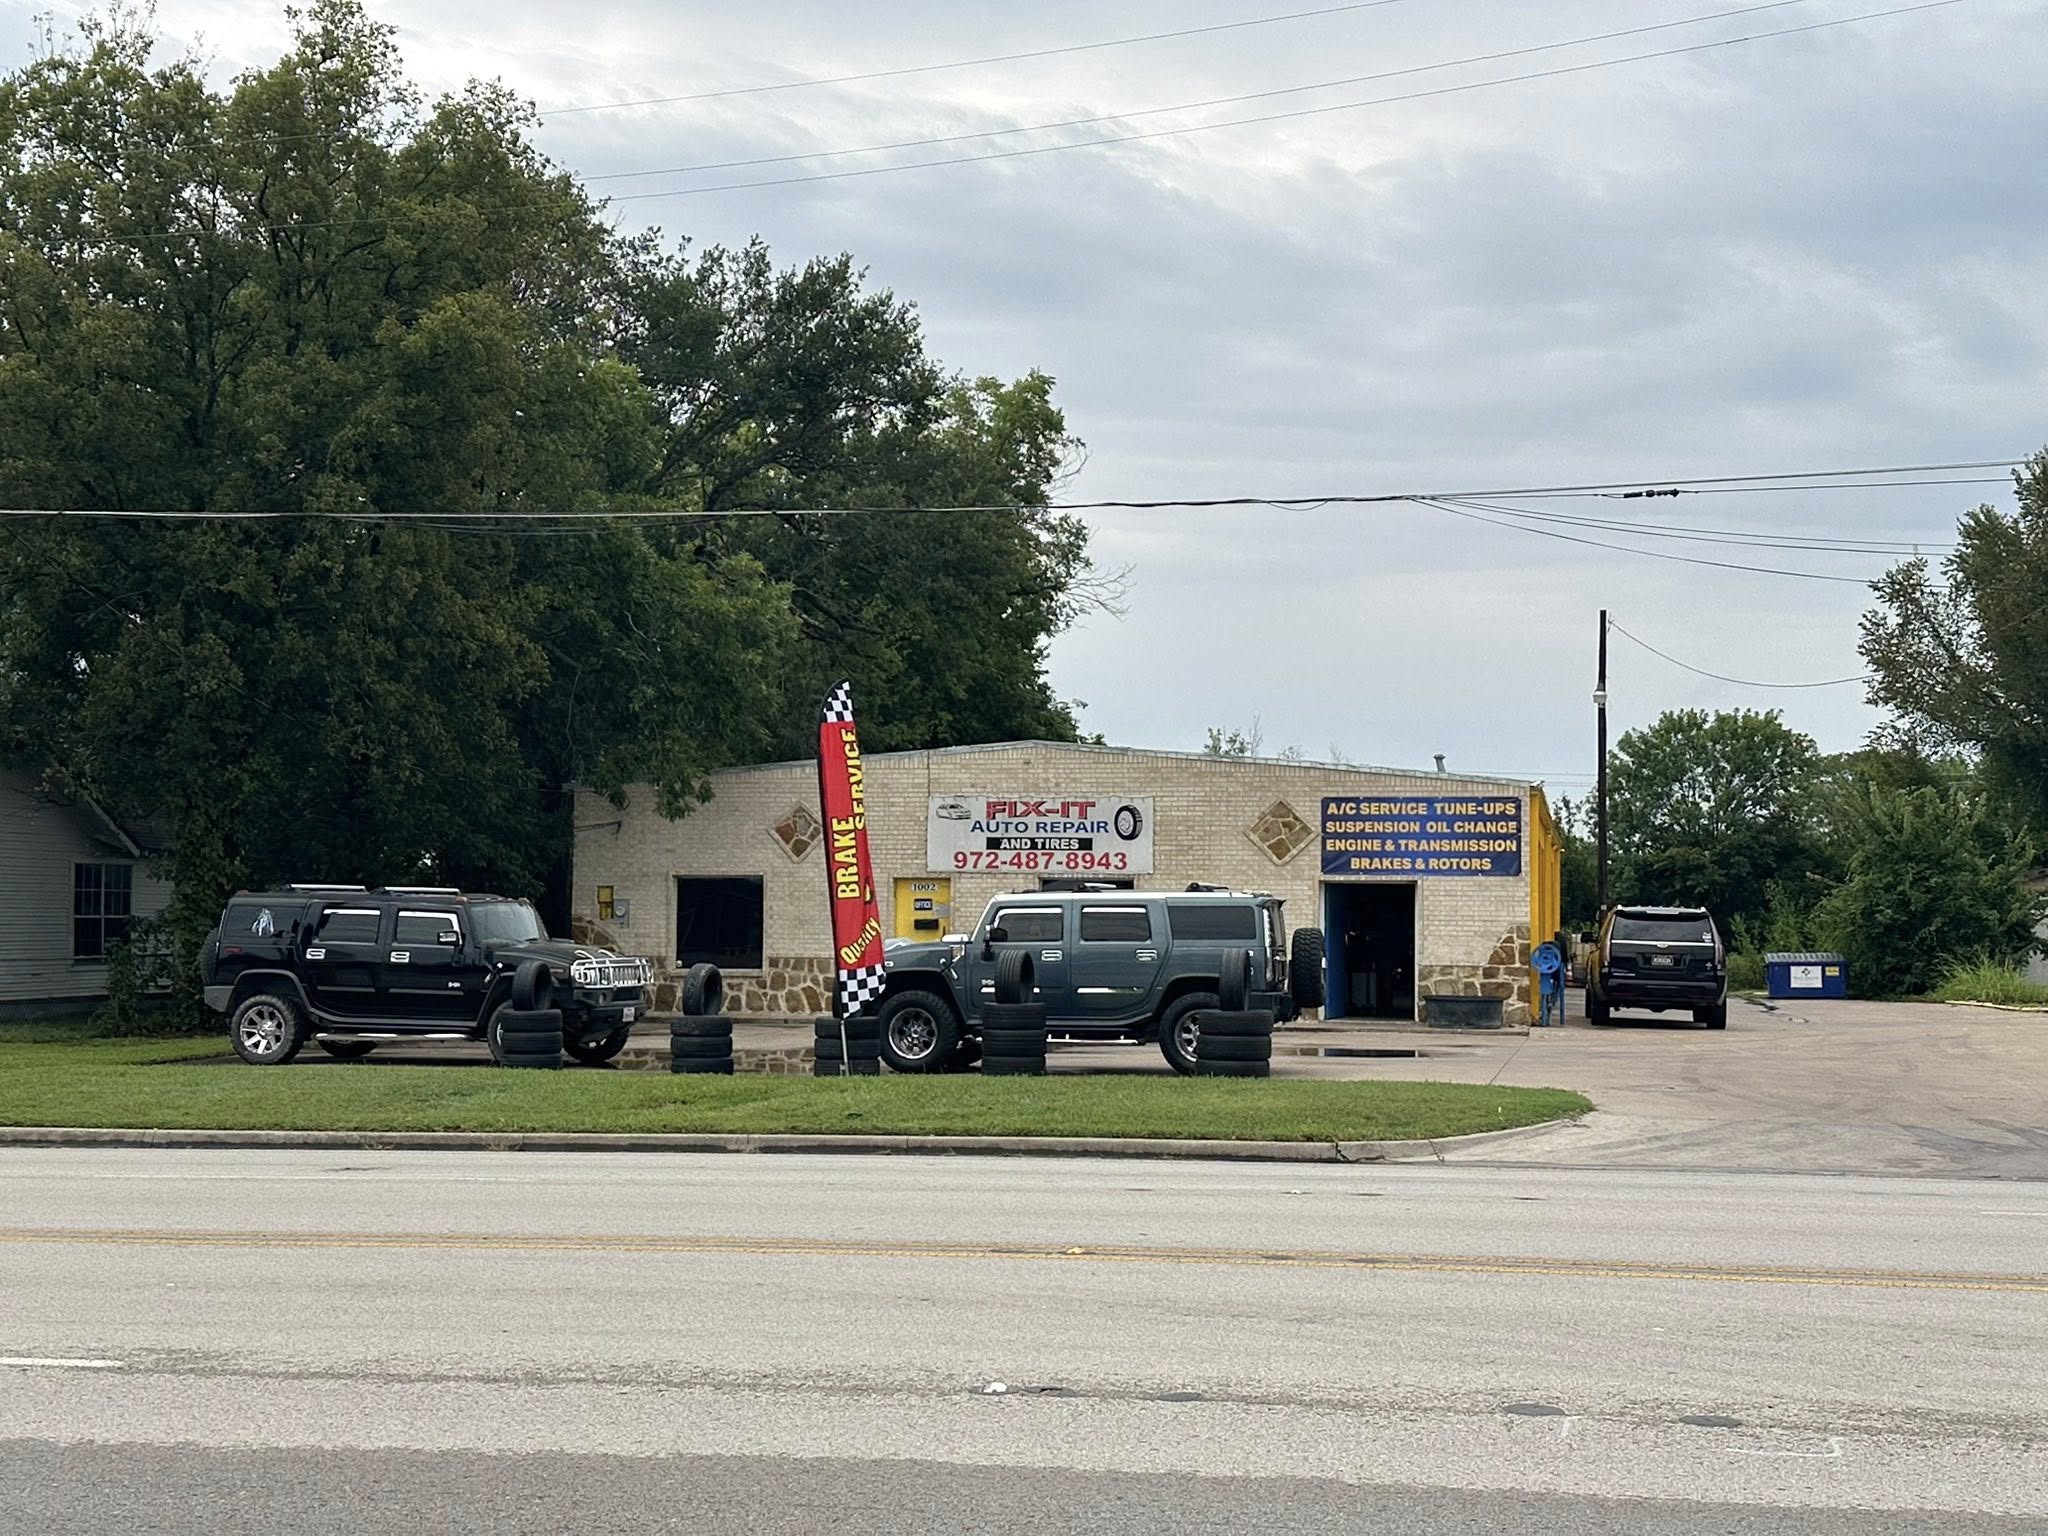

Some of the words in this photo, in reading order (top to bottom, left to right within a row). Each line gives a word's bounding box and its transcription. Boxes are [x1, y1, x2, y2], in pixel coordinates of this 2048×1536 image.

[986, 801, 1096, 819] FIX-IT
[1327, 802, 1357, 815] A/C
[1359, 802, 1428, 815] SERVICE
[1434, 802, 1516, 815] TUNE-UPS
[970, 820, 1029, 834] AUTO
[1035, 821, 1109, 834] REPAIR
[1325, 821, 1420, 833] SUSPENSION
[1426, 821, 1451, 833] OIL
[1453, 820, 1517, 833] CHANGE
[1000, 838, 1031, 850] AND
[1035, 838, 1080, 850] TIRES
[1326, 839, 1382, 851] ENGINE
[1384, 839, 1396, 851] &
[1398, 839, 1517, 852] TRANSMISSION
[832, 815, 860, 899] BRAKE
[953, 851, 1128, 871] 972-487-8943
[1350, 857, 1412, 870] BRAKES
[1415, 857, 1426, 870] &
[1429, 857, 1492, 870] ROTORS
[913, 883, 936, 891] 1002
